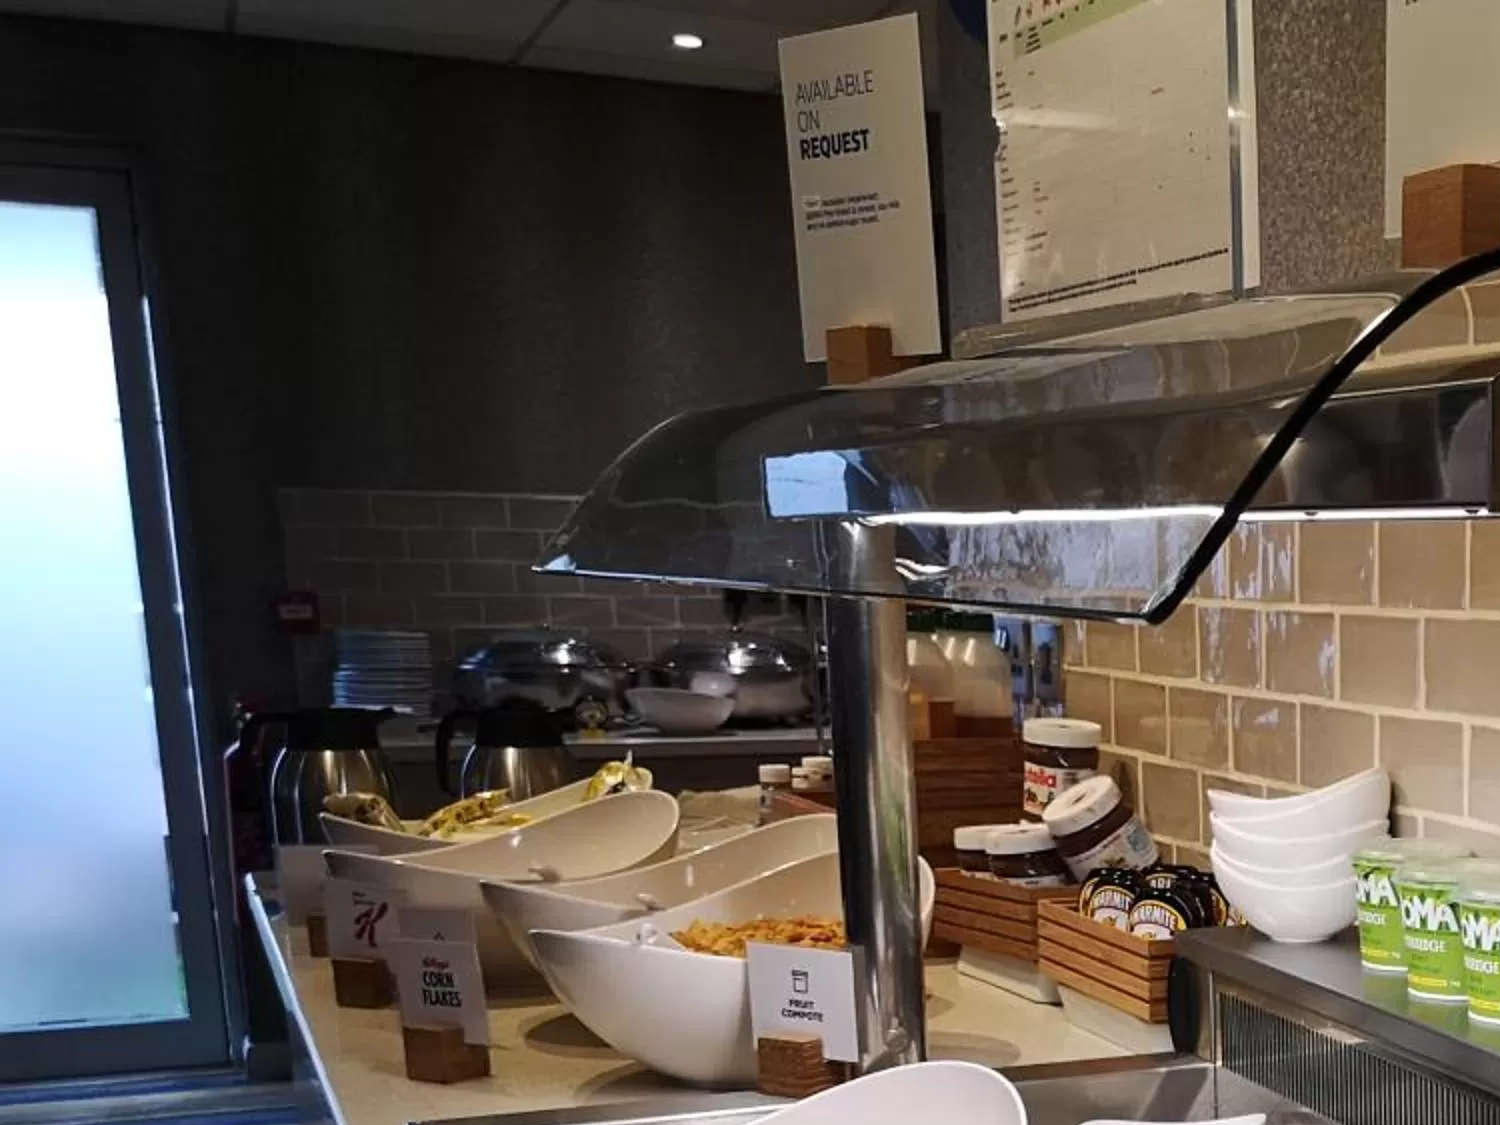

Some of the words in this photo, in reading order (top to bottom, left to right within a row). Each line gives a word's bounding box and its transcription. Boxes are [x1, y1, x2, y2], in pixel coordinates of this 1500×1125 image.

[795, 70, 874, 105] AVAILABLE
[797, 109, 820, 133] ON
[799, 128, 869, 160] REQUEST
[1401, 894, 1460, 932] OMA
[422, 971, 454, 988] CORN
[422, 988, 462, 1008] FLAKES
